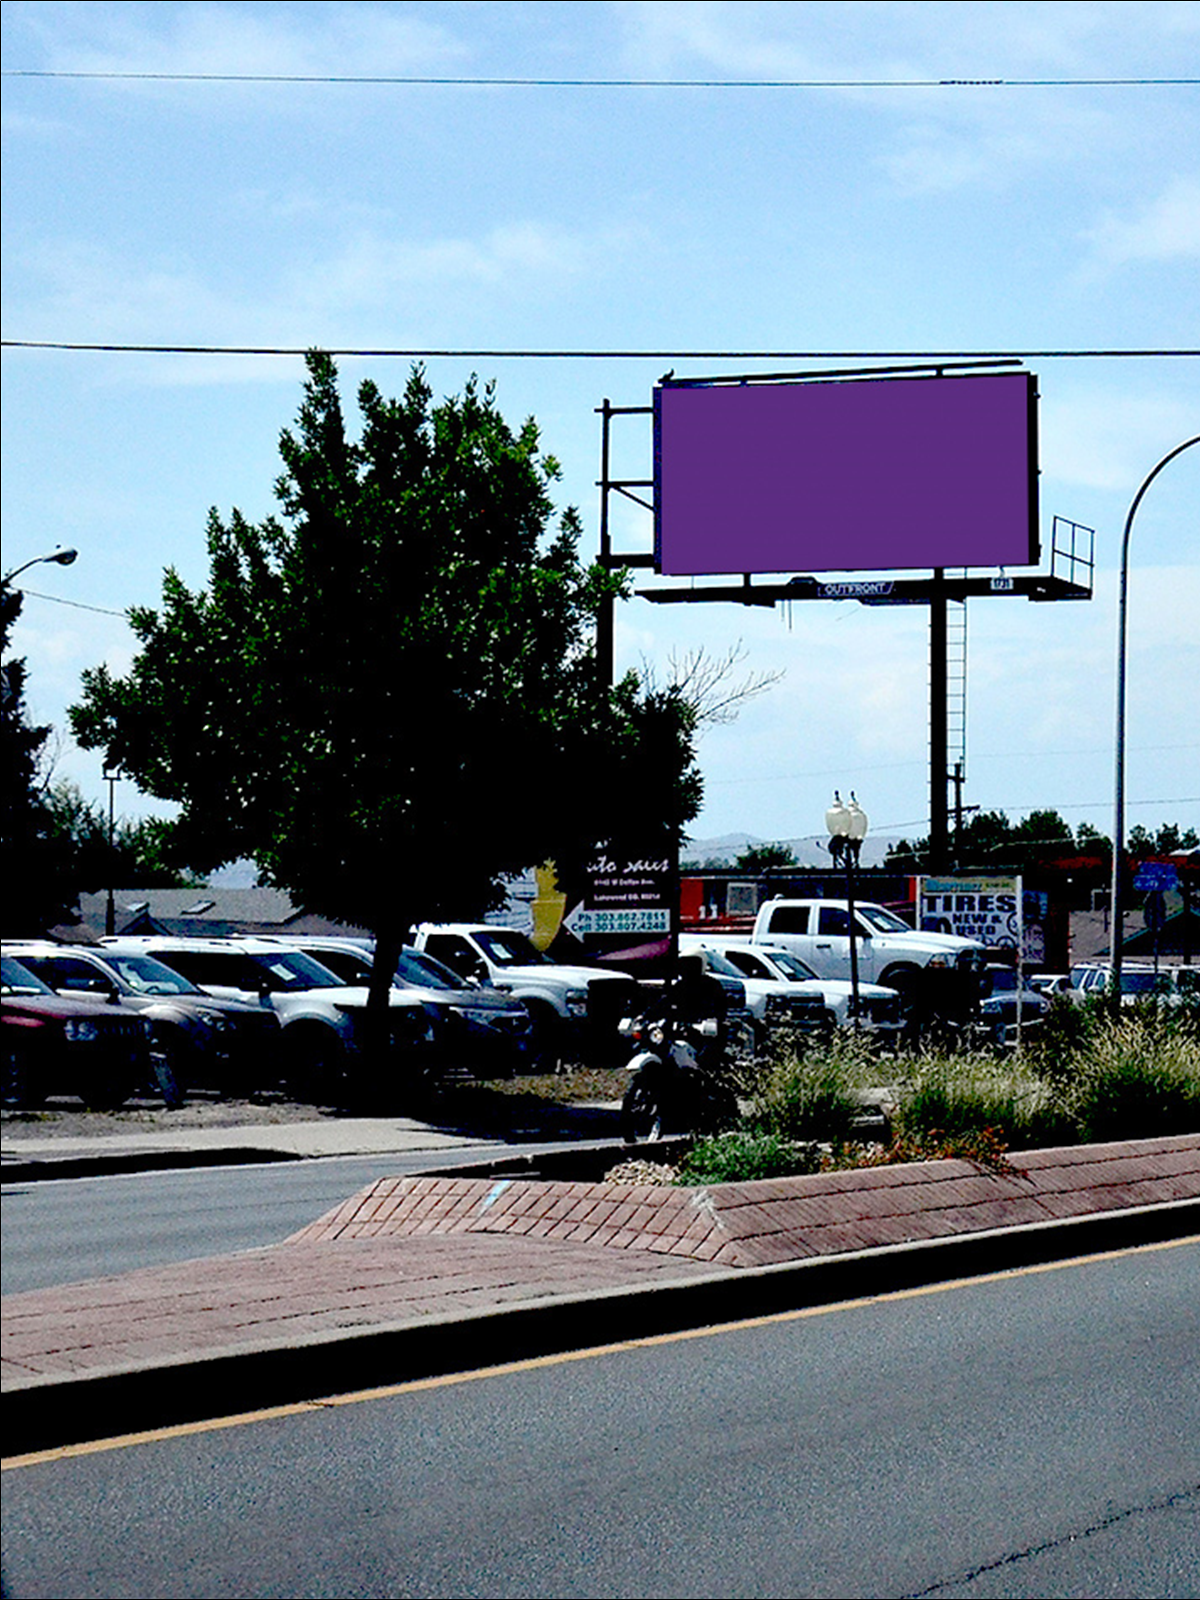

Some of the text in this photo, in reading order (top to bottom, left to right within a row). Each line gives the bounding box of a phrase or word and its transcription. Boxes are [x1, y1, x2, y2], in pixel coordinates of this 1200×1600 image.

[824, 581, 886, 596] OUTFRONT
[923, 895, 1017, 912] TIRES
[578, 913, 592, 922] Ph
[953, 913, 988, 924] NEW
[571, 922, 592, 932] Cell
[956, 926, 996, 935] USED
